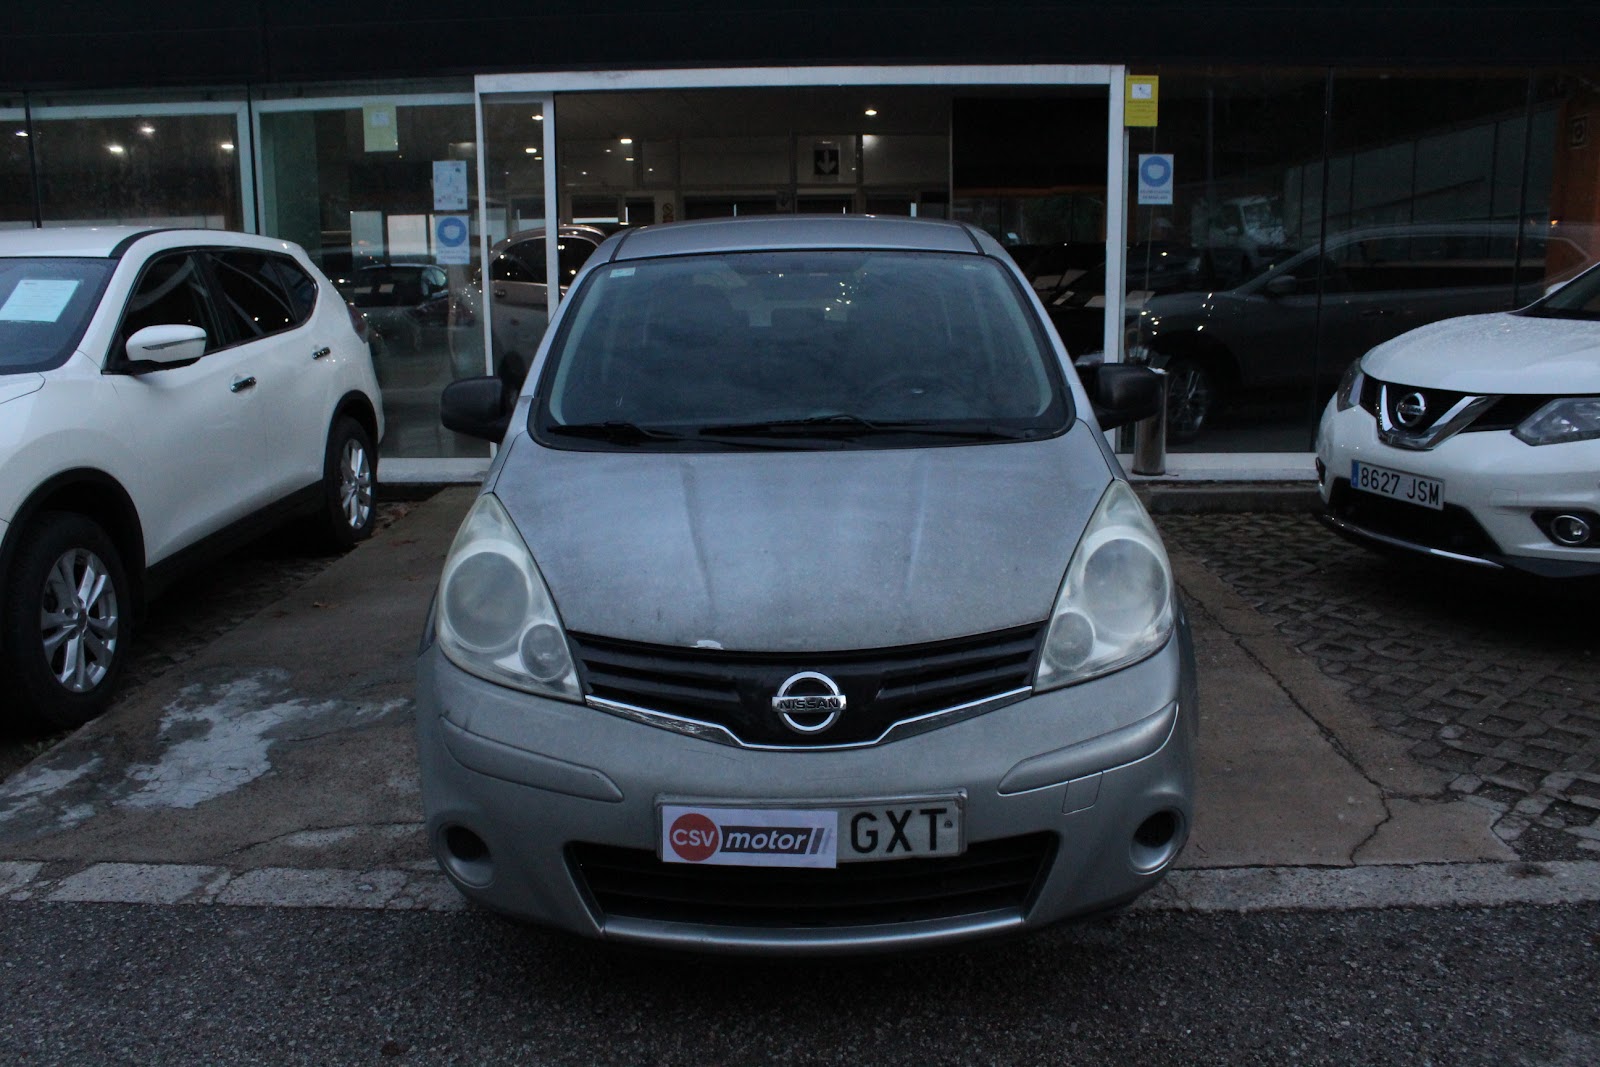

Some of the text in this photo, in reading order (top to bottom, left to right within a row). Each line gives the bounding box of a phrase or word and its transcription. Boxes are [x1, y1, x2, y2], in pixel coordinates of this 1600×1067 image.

[1361, 467, 1440, 506] 8627 JSM
[779, 698, 840, 710] NISSAN
[672, 828, 718, 848] CSV
[850, 808, 948, 854] GXT
